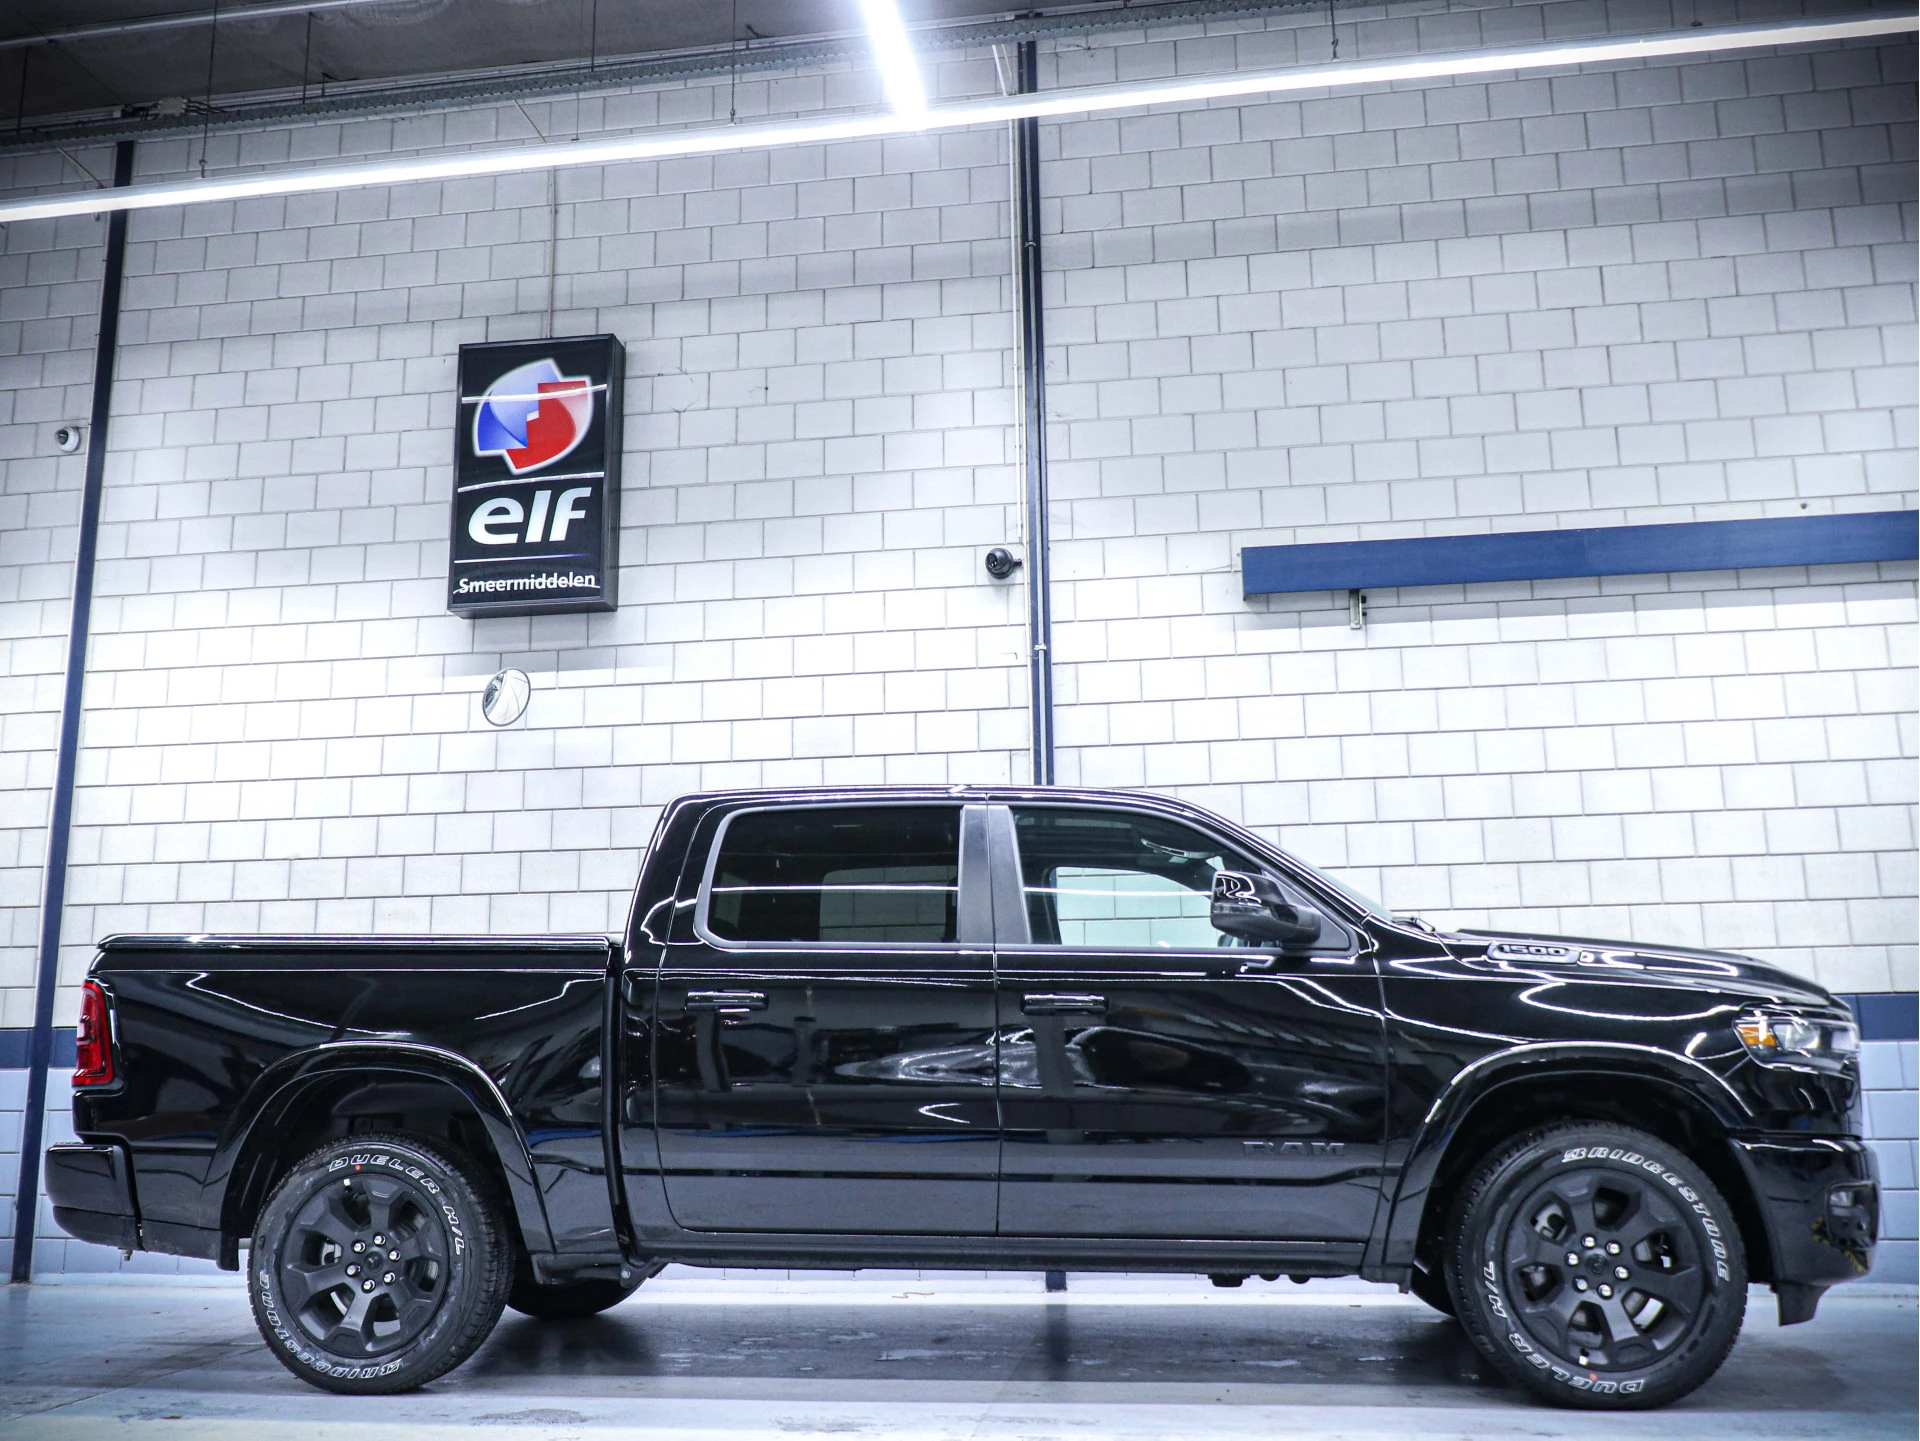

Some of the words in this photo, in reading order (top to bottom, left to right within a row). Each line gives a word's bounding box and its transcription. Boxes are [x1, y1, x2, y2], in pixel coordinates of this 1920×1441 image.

[467, 486, 592, 545] elf
[458, 571, 596, 594] Smeermiddelen
[1499, 944, 1570, 956] 1500
[328, 1153, 440, 1194] DUELER
[1243, 1141, 1345, 1156] RAM
[1561, 1146, 1731, 1283] BRIDGESTONE
[259, 1270, 403, 1380] BRIDGESTONE
[1508, 1332, 1645, 1394] DUELER
